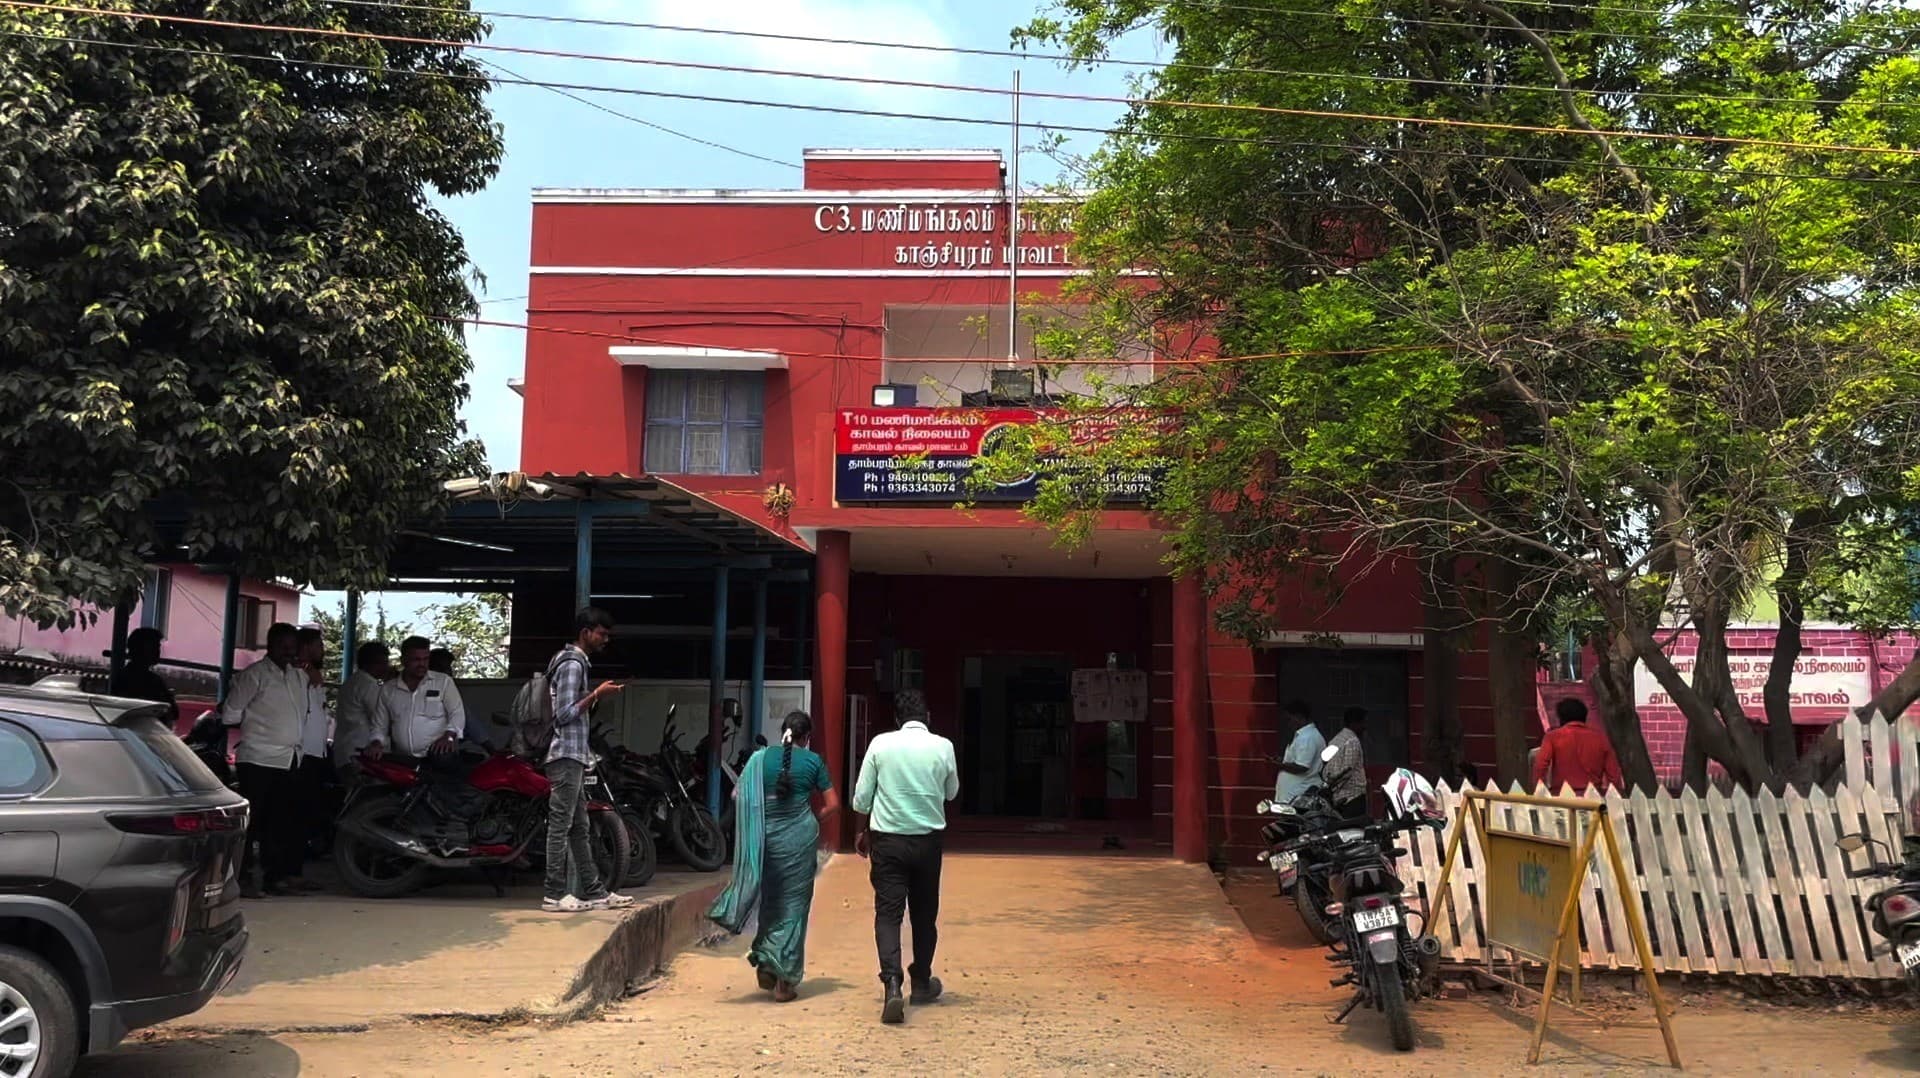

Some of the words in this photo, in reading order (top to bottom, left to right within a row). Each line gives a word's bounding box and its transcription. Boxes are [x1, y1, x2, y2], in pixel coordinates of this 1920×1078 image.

[814, 205, 857, 231] C3.
[861, 203, 996, 232] மணிமங்கலம்
[894, 240, 994, 269] காஞ்சிபுரம்
[842, 412, 868, 425] T10
[850, 428, 899, 439] காவல்
[902, 426, 971, 441] நிலையம்
[864, 472, 878, 482] Ph
[864, 483, 878, 493] Ph
[888, 483, 956, 493] 9363343074
